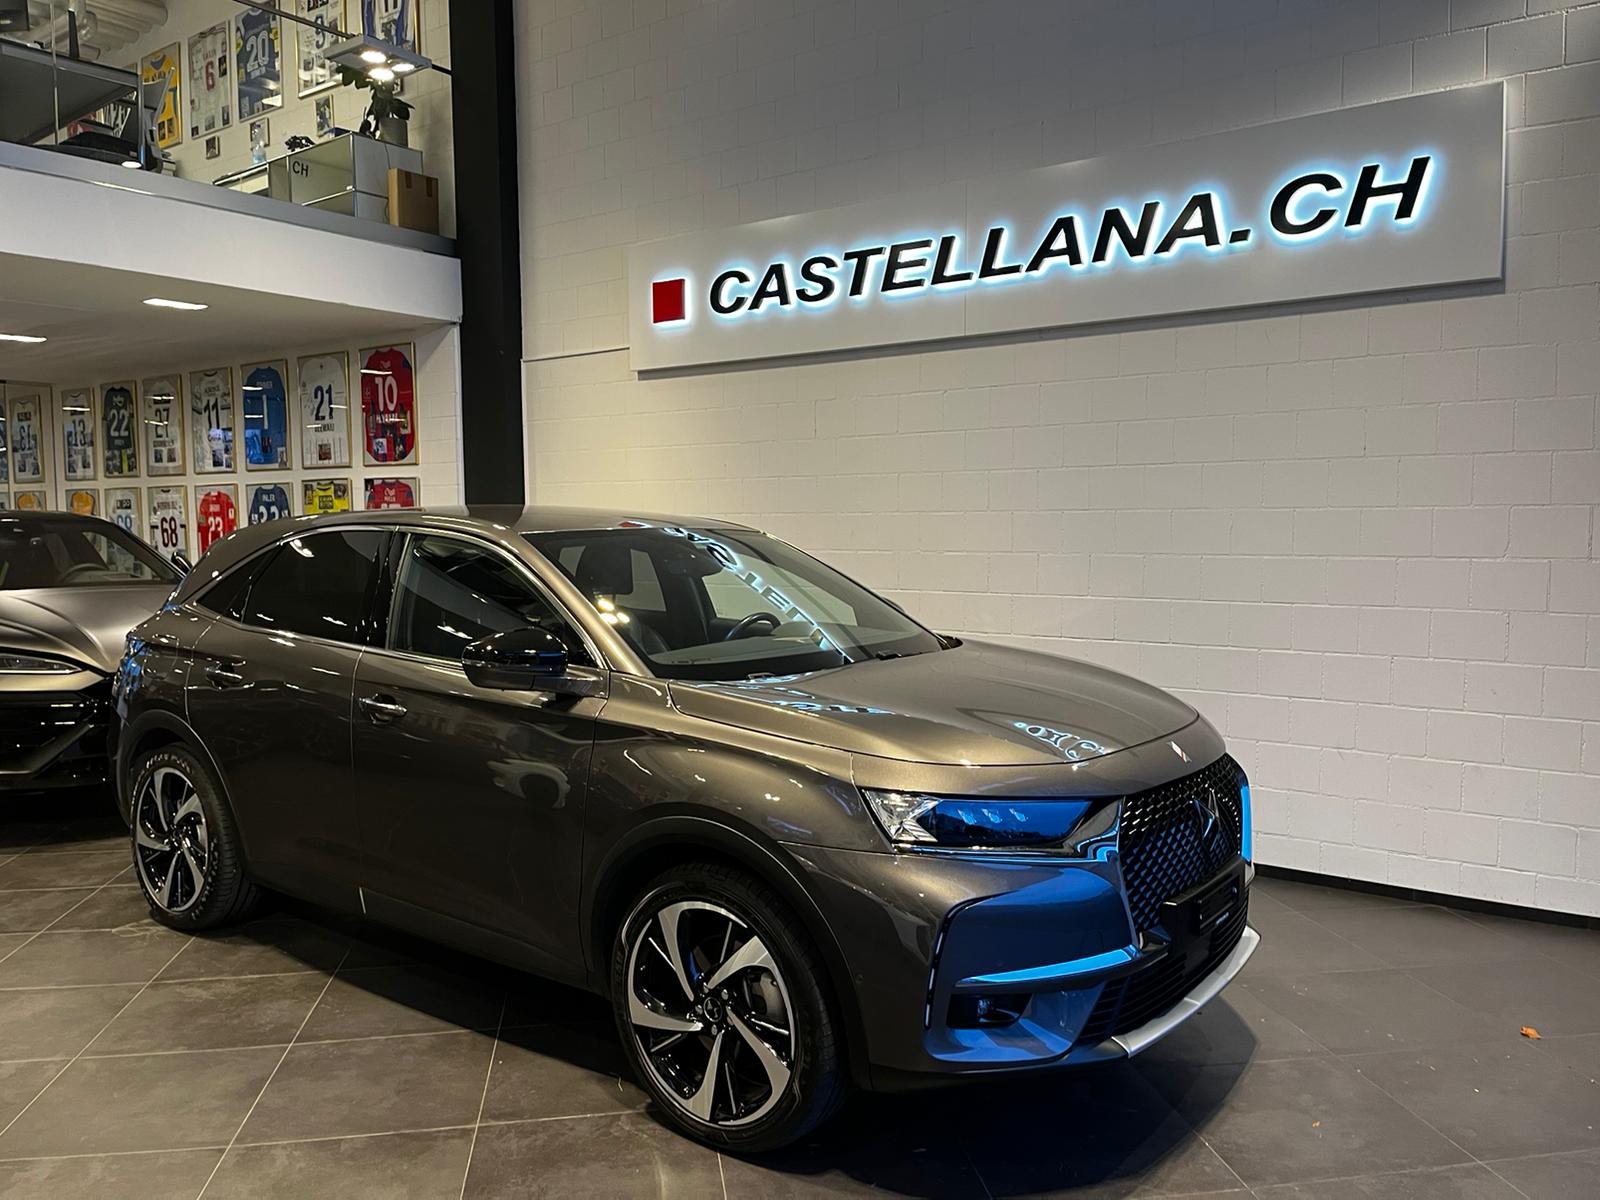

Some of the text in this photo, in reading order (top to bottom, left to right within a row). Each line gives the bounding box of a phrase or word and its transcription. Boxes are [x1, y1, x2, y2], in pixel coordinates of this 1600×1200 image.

[246, 30, 269, 72] 20
[205, 60, 215, 91] 6
[292, 160, 309, 177] CH
[708, 155, 1431, 315] CASTELLANA.CH
[313, 384, 334, 421] 21
[374, 375, 398, 412] 10
[110, 409, 129, 437] 22
[203, 397, 220, 430] 11
[160, 516, 179, 548] 68
